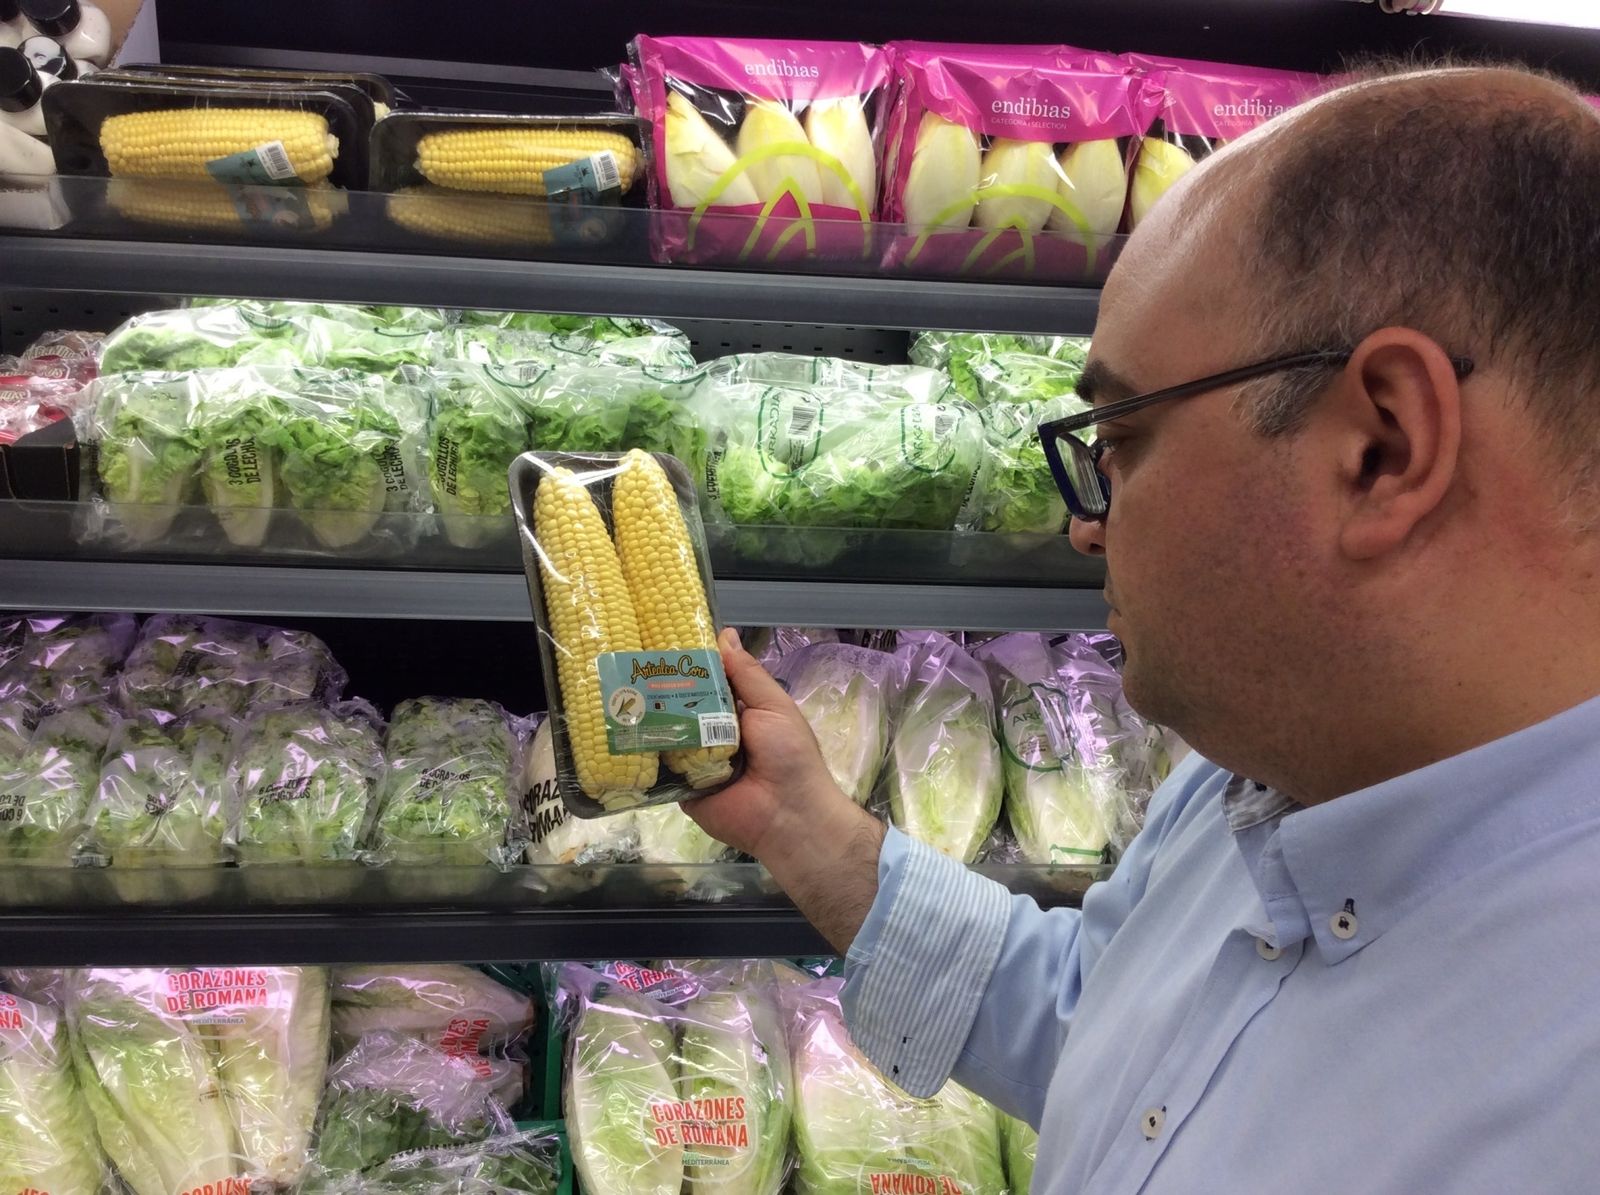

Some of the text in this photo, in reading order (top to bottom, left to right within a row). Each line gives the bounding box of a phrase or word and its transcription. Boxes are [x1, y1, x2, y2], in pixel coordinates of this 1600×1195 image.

[744, 58, 819, 78] endibias
[991, 96, 1071, 119] endibias
[244, 471, 262, 484] DE
[445, 440, 460, 496] DE LECHUGA
[398, 478, 409, 490] DE
[678, 654, 710, 679] Corn
[167, 968, 268, 994] CORAZONES
[165, 987, 269, 1014] DE ROMANA
[651, 1096, 746, 1123] CORAZONES
[655, 1124, 749, 1148] DE ROMANA
[869, 1172, 937, 1195] ROMANA
